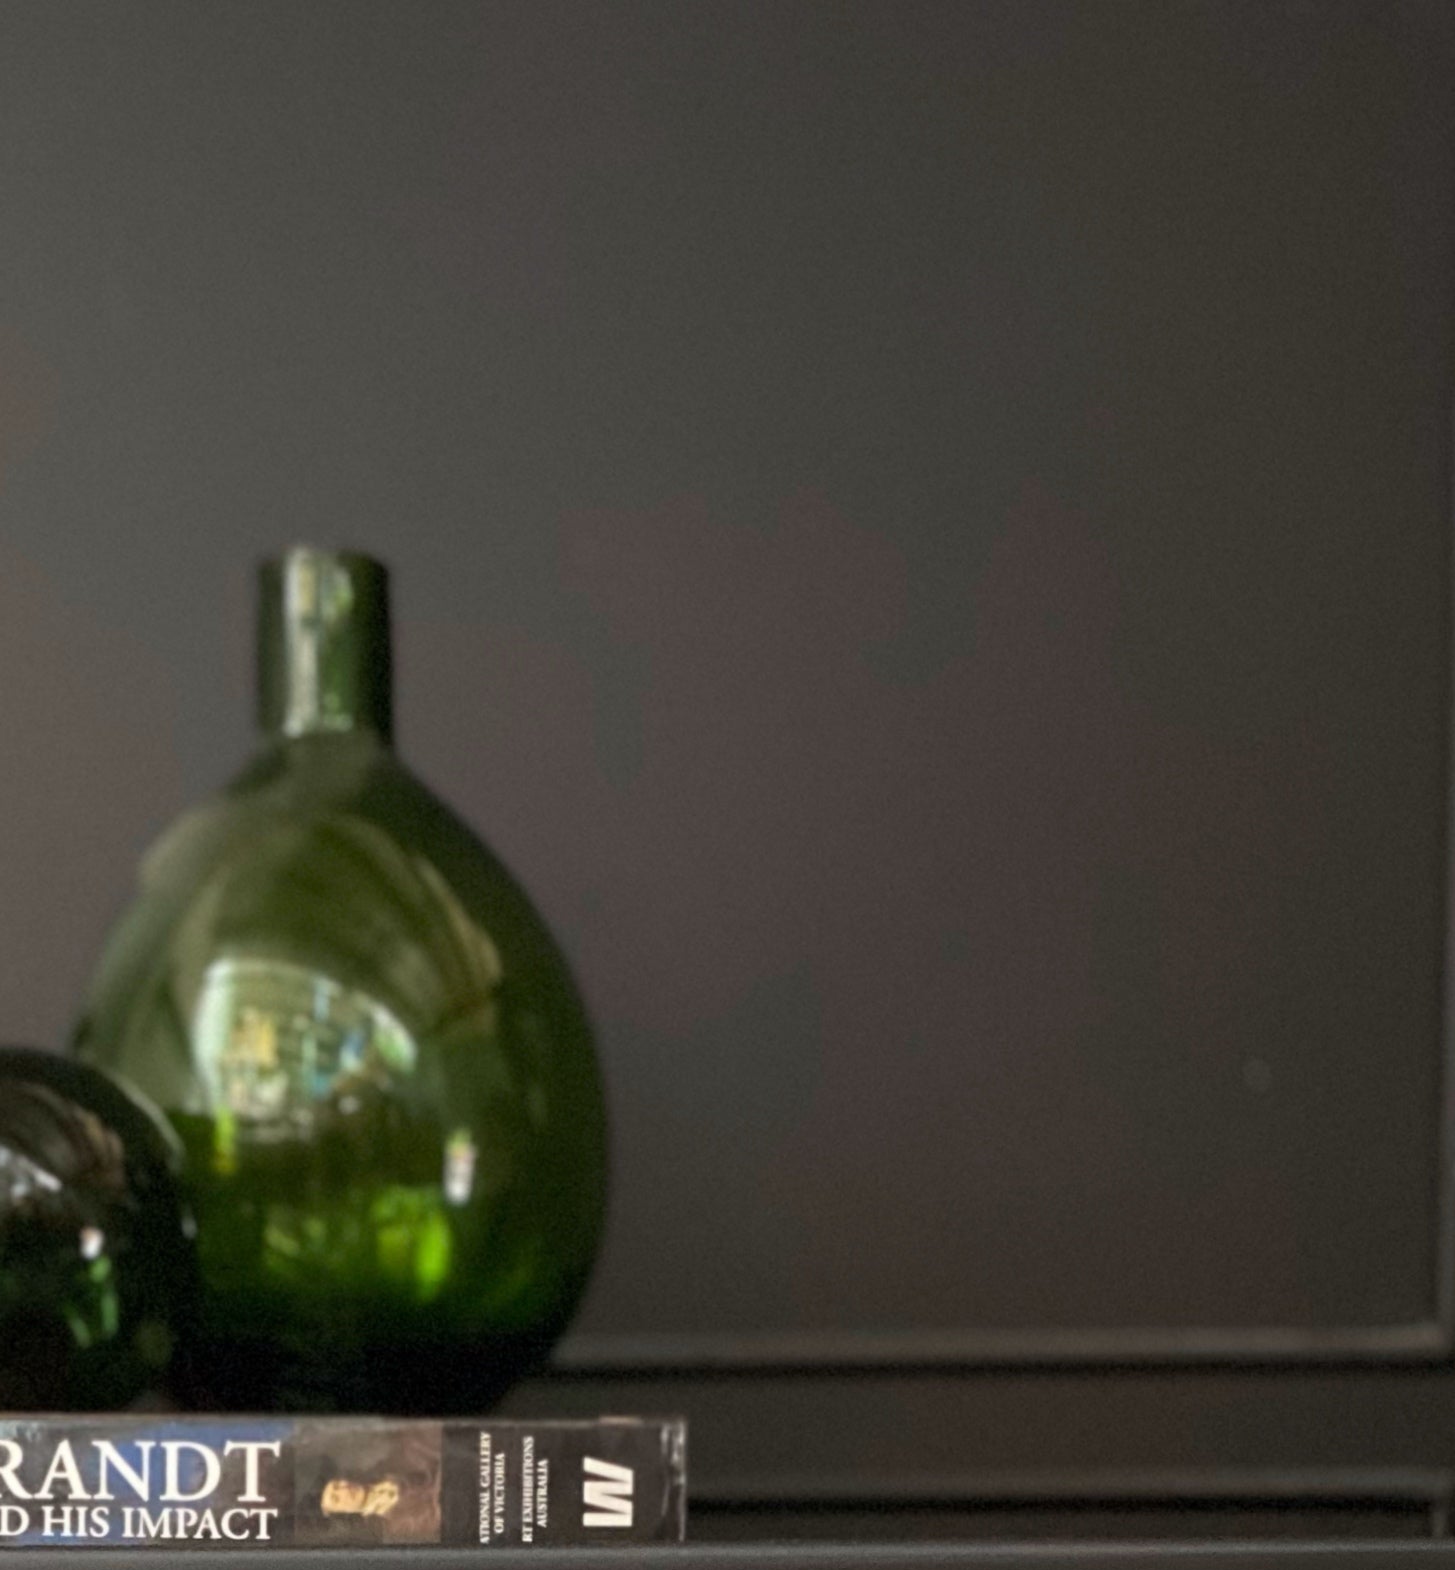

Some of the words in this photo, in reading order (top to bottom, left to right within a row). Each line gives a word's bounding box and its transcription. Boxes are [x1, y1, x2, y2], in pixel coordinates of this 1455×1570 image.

[479, 1431, 491, 1488] GALLERY
[493, 1452, 505, 1514] VICTORIA
[522, 1435, 534, 1523] EXHIBITIONS
[536, 1459, 548, 1528] AUSTRALIA
[41, 1506, 110, 1538] HIS
[121, 1507, 279, 1541] IMPACT
[493, 1515, 505, 1534] OF
